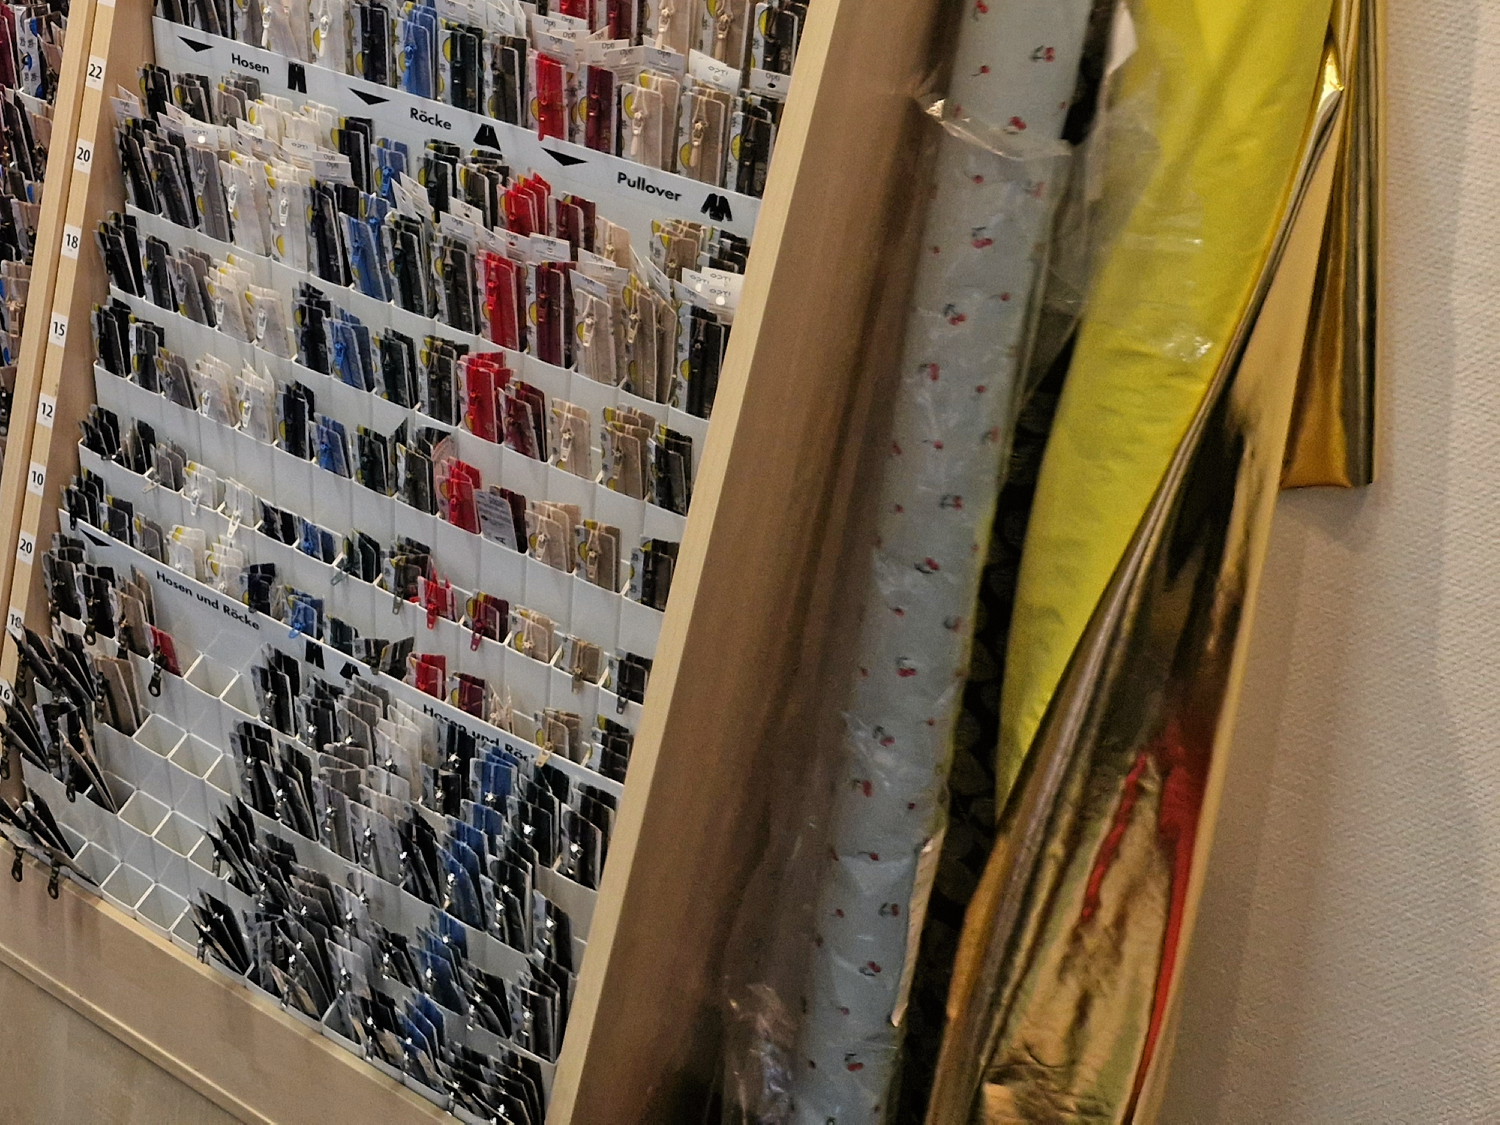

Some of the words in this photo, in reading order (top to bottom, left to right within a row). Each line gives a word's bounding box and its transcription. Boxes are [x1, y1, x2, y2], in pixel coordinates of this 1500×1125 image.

[88, 63, 104, 80] 22
[230, 51, 270, 76] Hosen
[409, 105, 452, 132] Röcke
[76, 146, 92, 163] 20
[616, 170, 683, 204] Pullover
[65, 232, 79, 249] 18
[52, 321, 66, 337] 15
[40, 402, 54, 418] 12
[31, 470, 45, 486] 10
[19, 538, 33, 554] 20
[155, 570, 194, 598] Hosen
[196, 591, 220, 611] und
[222, 602, 260, 632] Röcke
